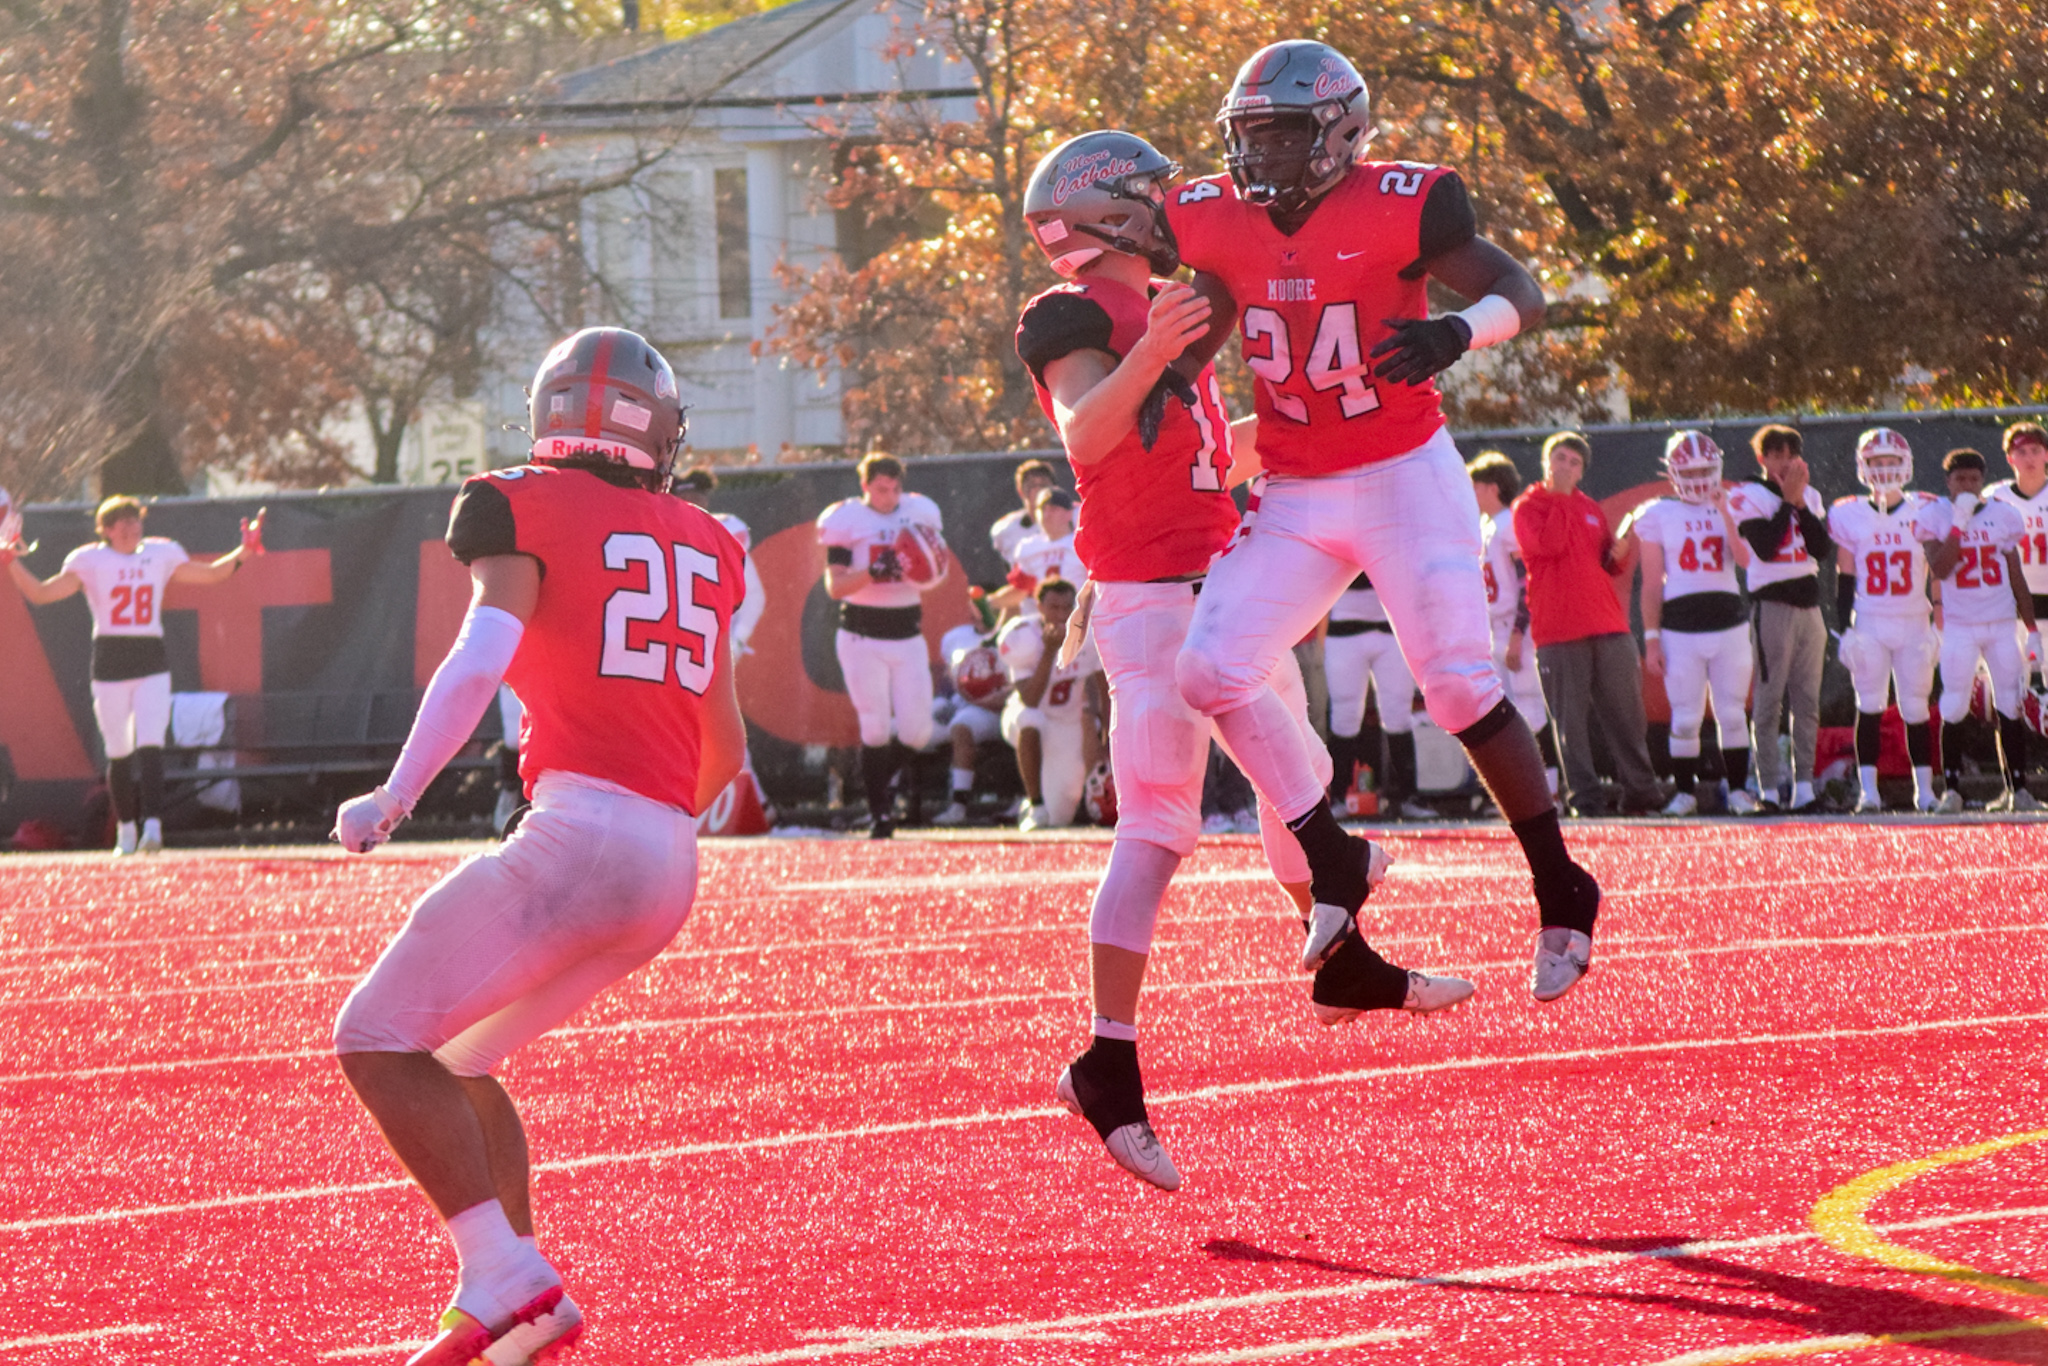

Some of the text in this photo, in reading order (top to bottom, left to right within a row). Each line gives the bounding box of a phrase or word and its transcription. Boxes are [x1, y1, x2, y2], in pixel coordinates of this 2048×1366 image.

[1053, 158, 1137, 206] Catholic
[1064, 150, 1111, 172] Moore
[1267, 279, 1316, 301] MOORE
[1244, 301, 1381, 425] 24
[1679, 536, 1723, 572] 43
[1956, 544, 2003, 589] 25
[2019, 532, 2047, 565] 11
[1865, 550, 1913, 596] 83
[111, 585, 154, 626] 28
[598, 532, 720, 697] 25
